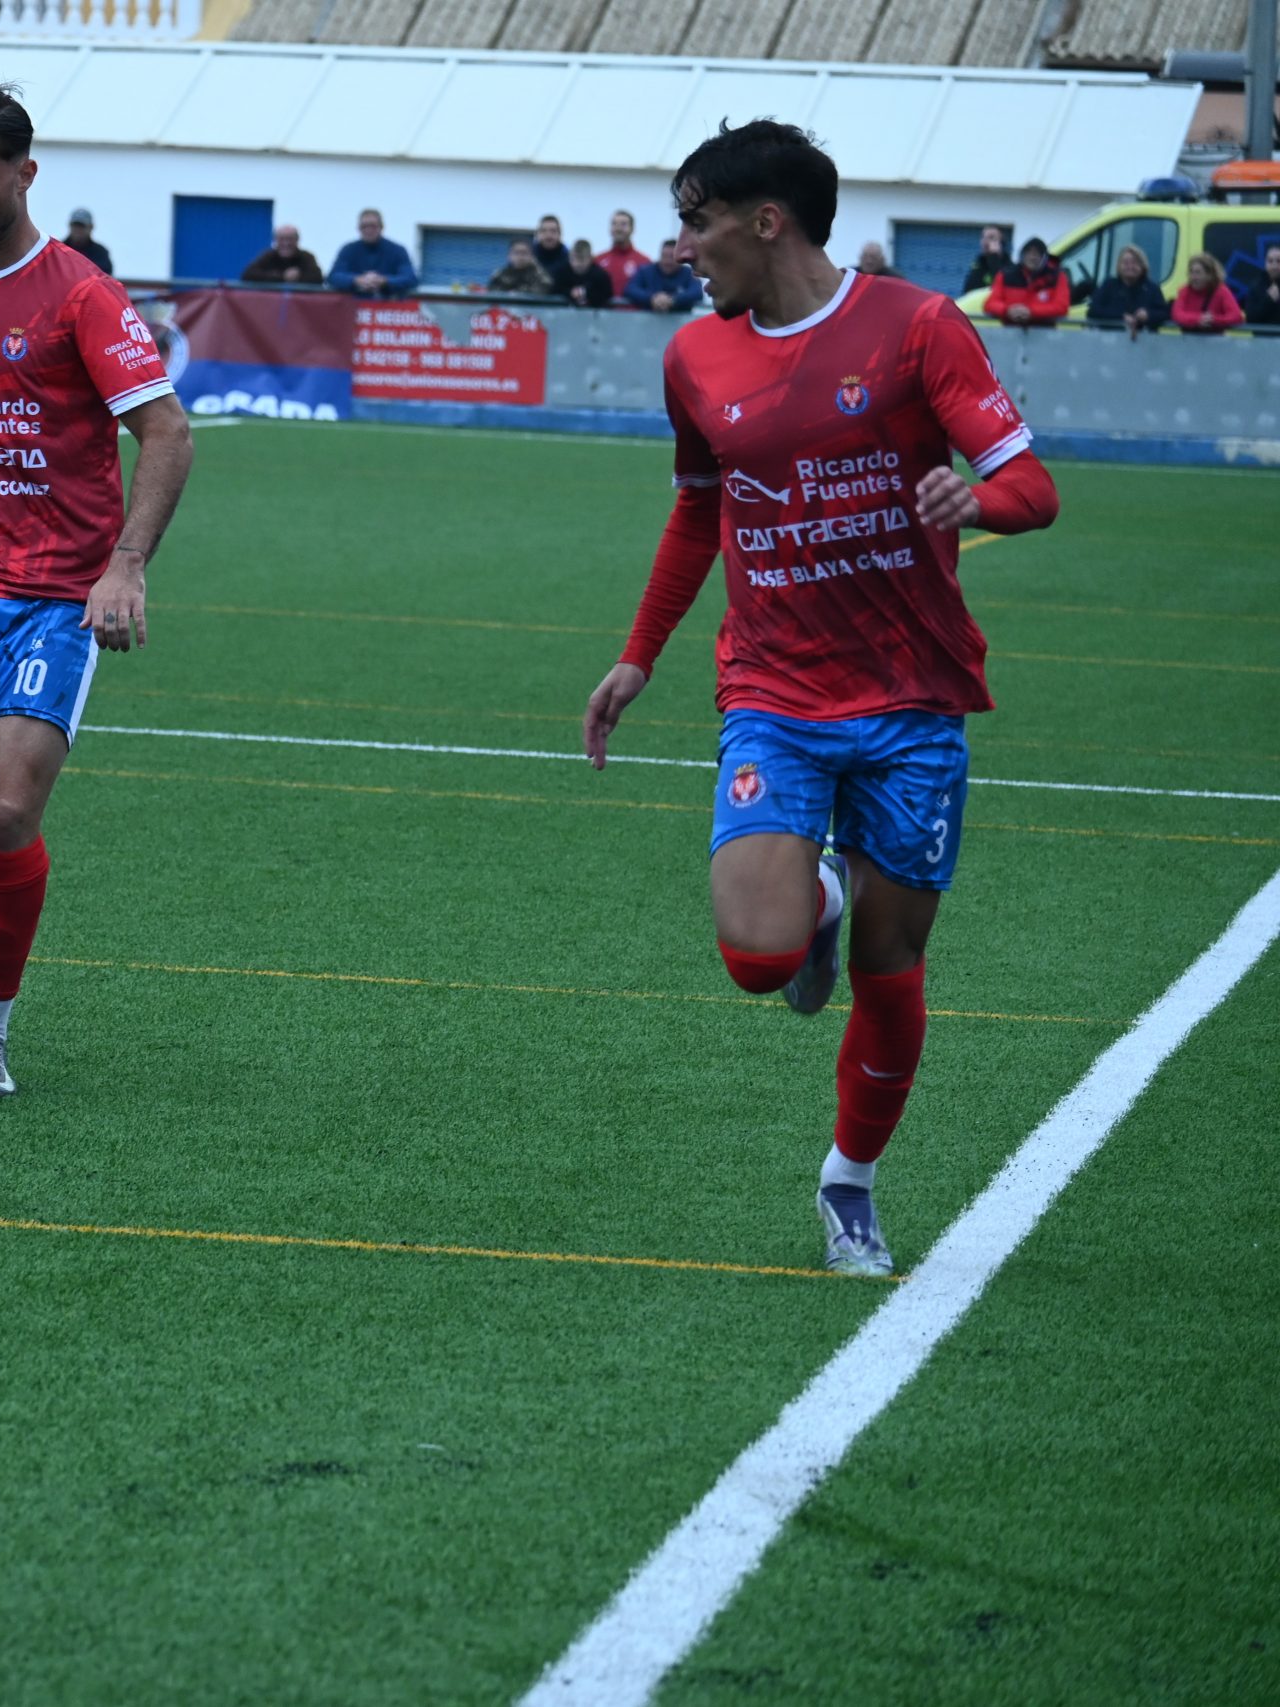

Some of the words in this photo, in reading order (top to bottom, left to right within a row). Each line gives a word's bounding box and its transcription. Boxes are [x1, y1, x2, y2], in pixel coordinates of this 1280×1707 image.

[104, 339, 133, 356] OBRAS
[117, 345, 146, 366] JIMA
[126, 353, 161, 370] ESTUDIOS
[796, 450, 900, 480] Ricardo
[801, 474, 904, 503] Fuentes
[790, 557, 854, 584] BLAYA
[13, 658, 49, 696] 10
[925, 818, 949, 864] 3
